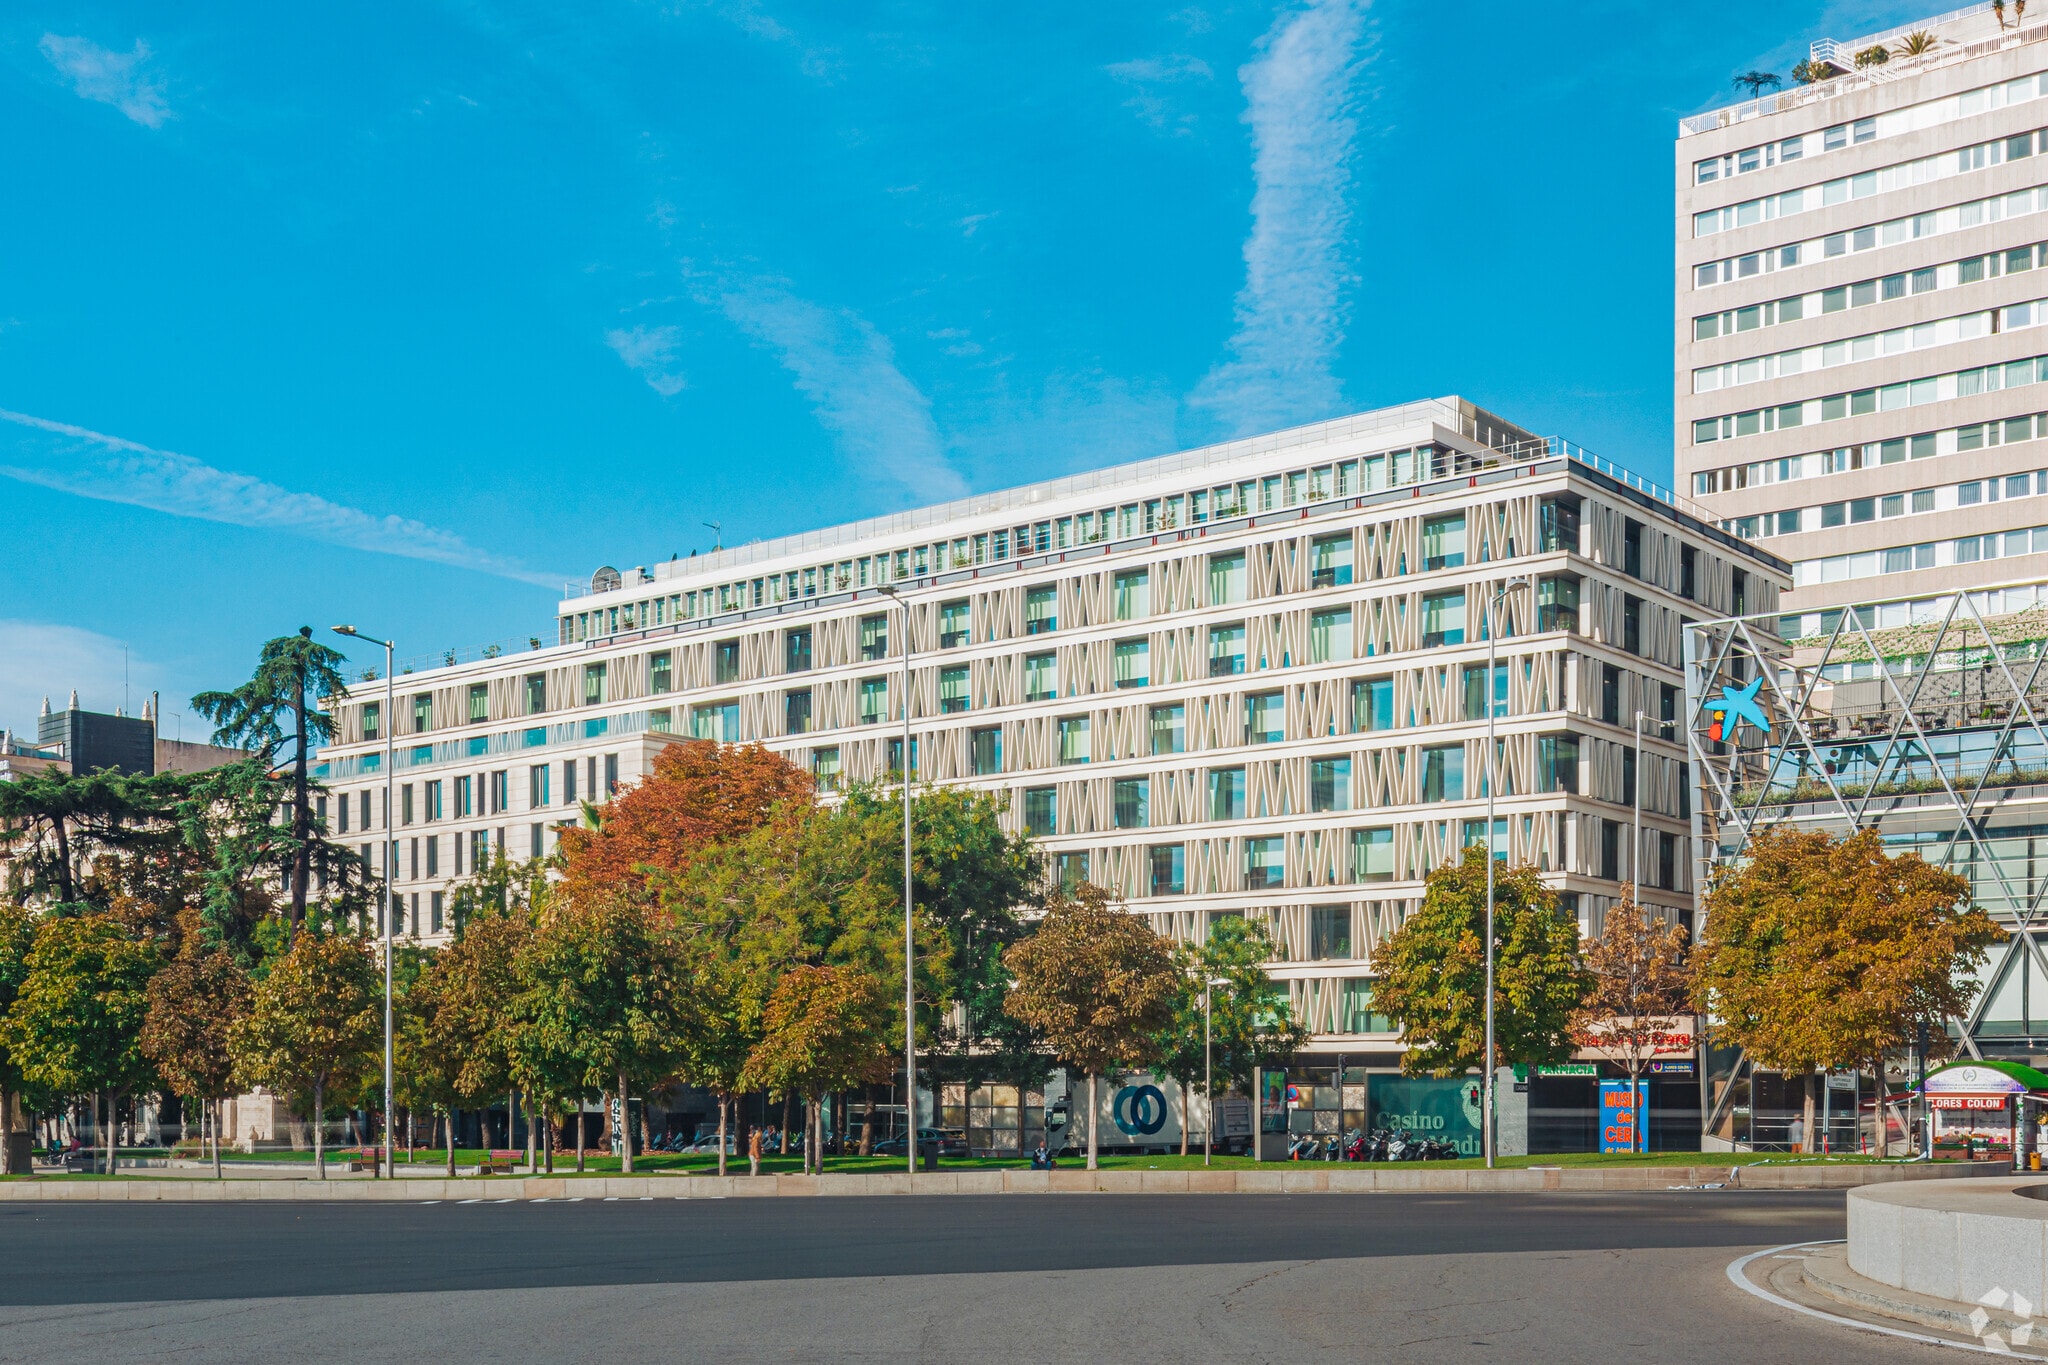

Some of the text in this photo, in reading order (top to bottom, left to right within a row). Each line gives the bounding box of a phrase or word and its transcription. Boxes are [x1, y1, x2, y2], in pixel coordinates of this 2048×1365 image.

[1537, 1065, 1595, 1076] FARMACIA
[1967, 1099, 2000, 1108] COLON
[1376, 1110, 1445, 1130] Casino
[1617, 1110, 1632, 1123] de
